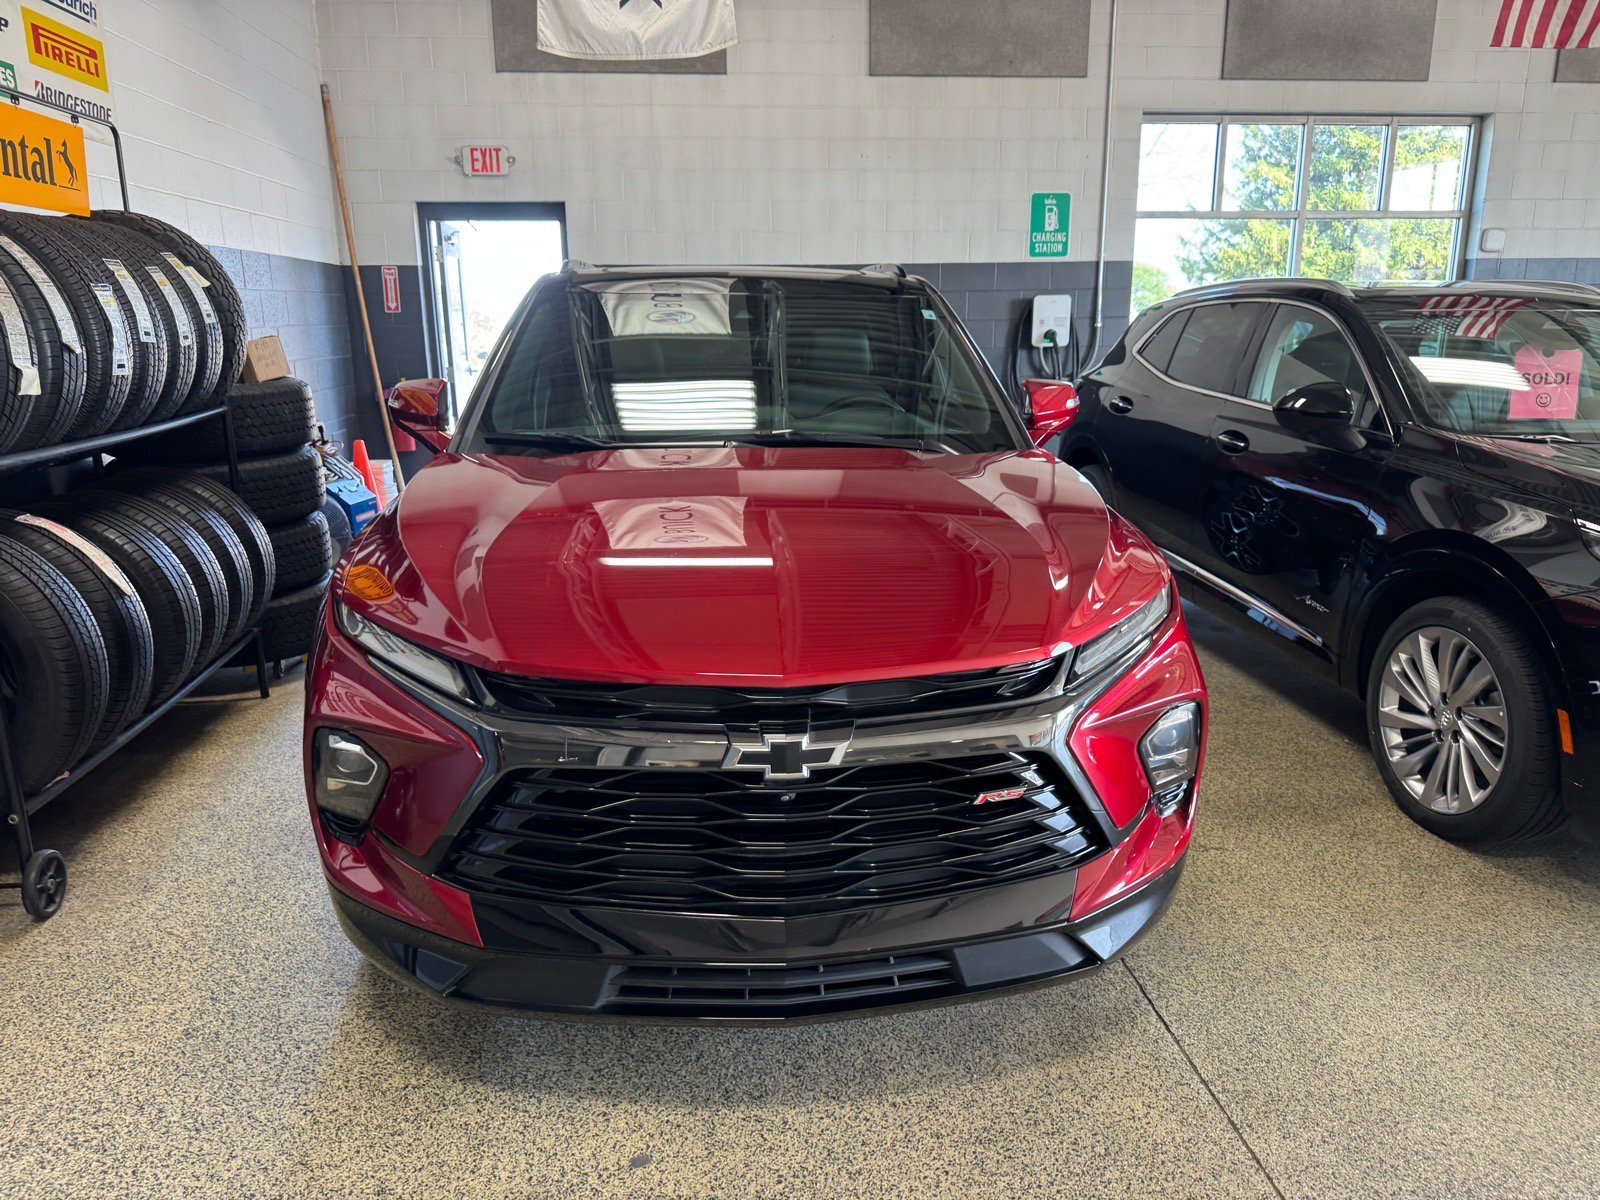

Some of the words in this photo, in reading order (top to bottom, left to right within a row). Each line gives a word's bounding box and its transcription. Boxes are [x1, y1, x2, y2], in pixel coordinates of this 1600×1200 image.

[30, 22, 100, 78] PIRELLI
[35, 80, 112, 121] BRIDGESTONE
[0, 135, 57, 186] ntal
[470, 148, 501, 172] EXIT
[1032, 232, 1067, 243] CHARGING
[1034, 243, 1063, 254] STATION
[1522, 372, 1571, 386] SOLD!
[974, 787, 1025, 805] RS
